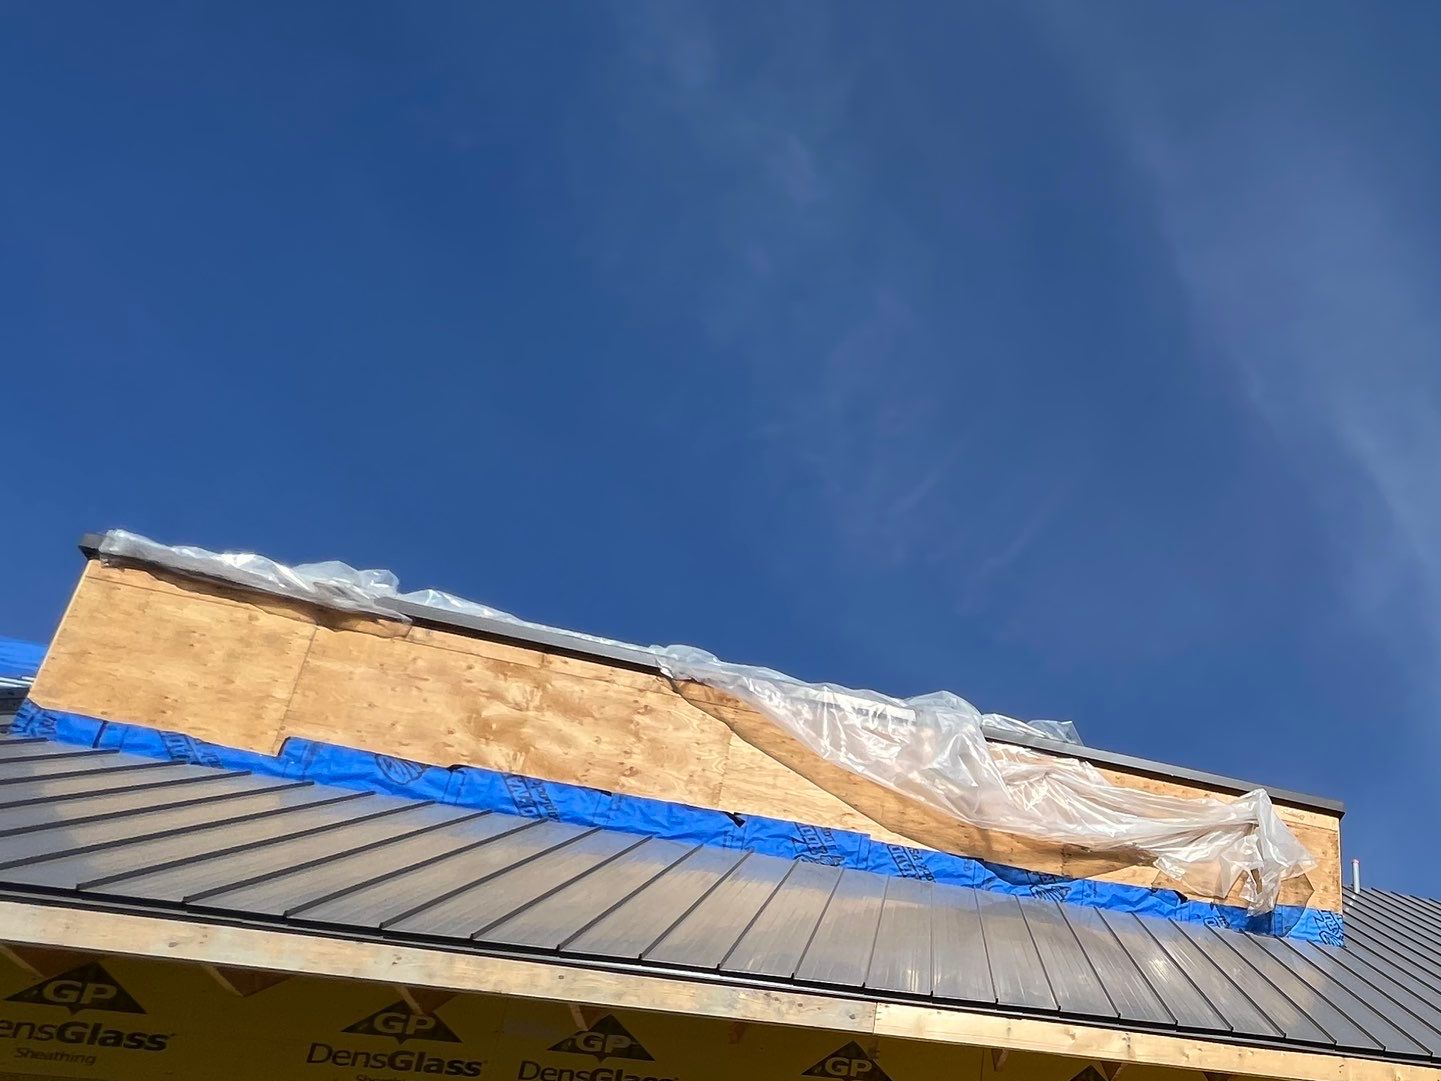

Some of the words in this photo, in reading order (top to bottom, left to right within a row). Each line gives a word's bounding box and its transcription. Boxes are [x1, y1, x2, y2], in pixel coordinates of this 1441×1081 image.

[43, 979, 118, 1005] GP
[374, 1012, 435, 1034] GP
[0, 1018, 169, 1051] ensGlass
[577, 1032, 633, 1052] GP
[14, 1047, 97, 1066] Sheathing
[305, 1041, 482, 1078] DensGlass
[825, 1057, 872, 1078] GP
